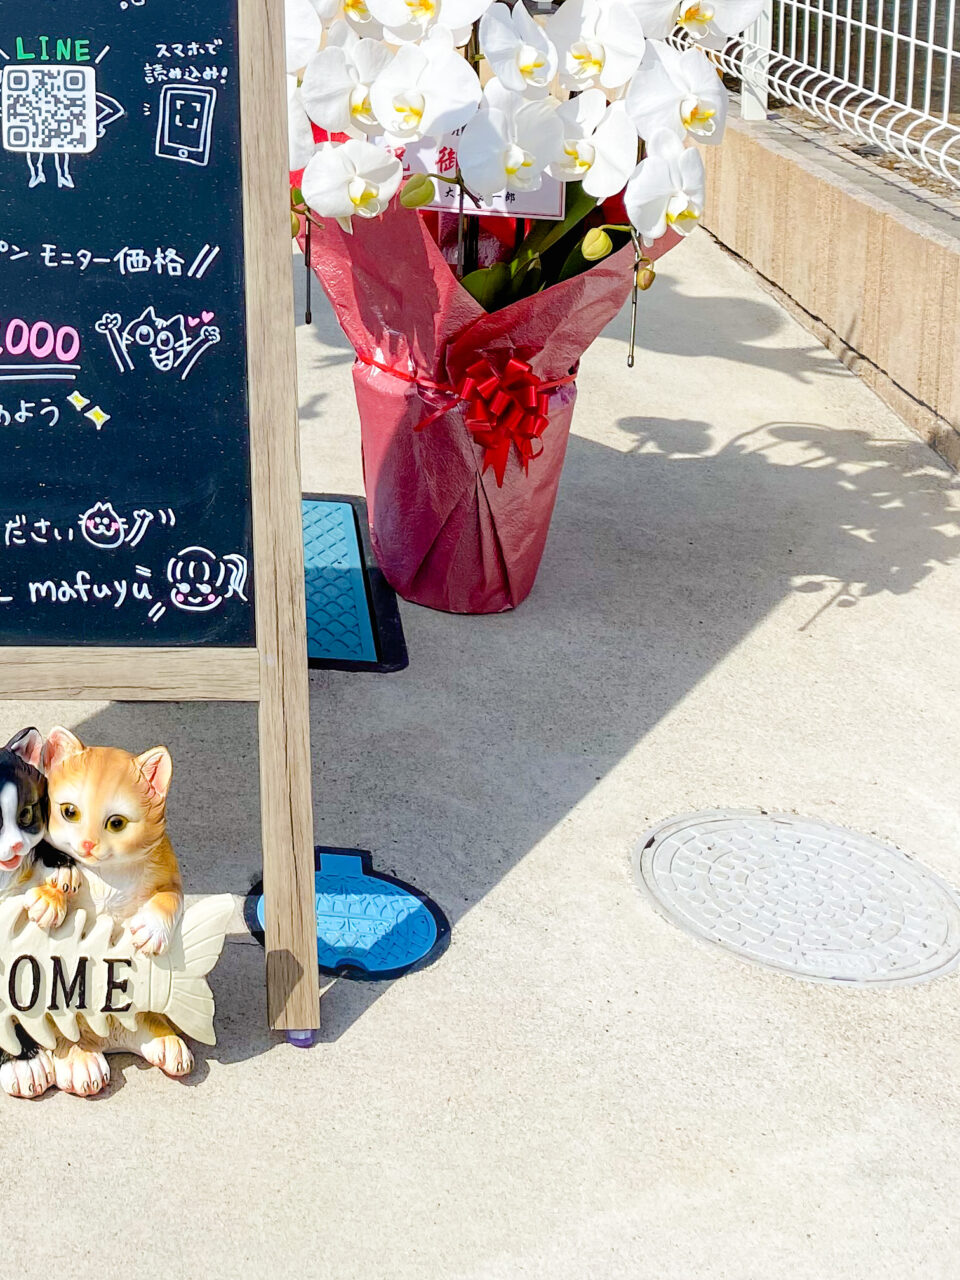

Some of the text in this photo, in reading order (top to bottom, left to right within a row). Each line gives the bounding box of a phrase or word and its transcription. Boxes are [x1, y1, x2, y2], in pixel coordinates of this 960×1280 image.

[17, 36, 91, 62] LINE
[156, 39, 222, 57] スマホで
[29, 570, 152, 607] mafuyu
